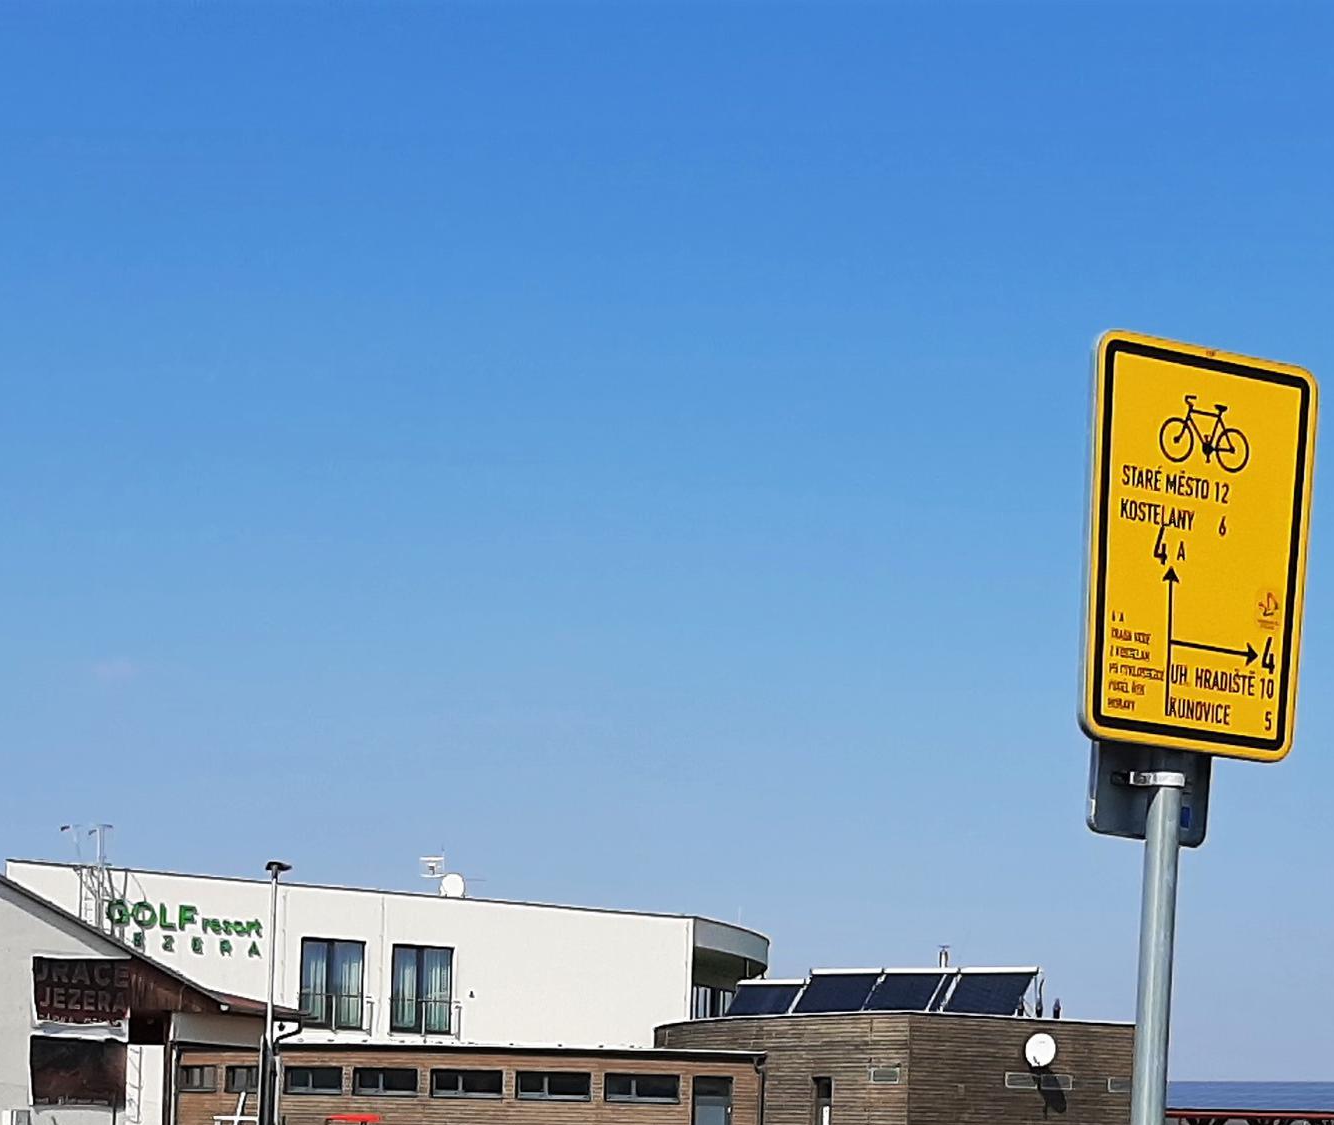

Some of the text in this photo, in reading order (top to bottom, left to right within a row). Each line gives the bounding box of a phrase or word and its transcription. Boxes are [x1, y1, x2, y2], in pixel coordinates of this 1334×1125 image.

[1121, 464, 1229, 504] STARÉ MĚSTO 12
[1120, 498, 1227, 537] KOSTELANY 6
[1153, 525, 1186, 566] 4 A
[1261, 636, 1275, 675] 4
[1195, 667, 1256, 697] HRADIŠTĚ
[1259, 678, 1275, 700] 10
[1169, 696, 1272, 731] KUNOVICE 5
[107, 899, 264, 938] GOLF resort
[39, 987, 126, 1013] JEZERA
